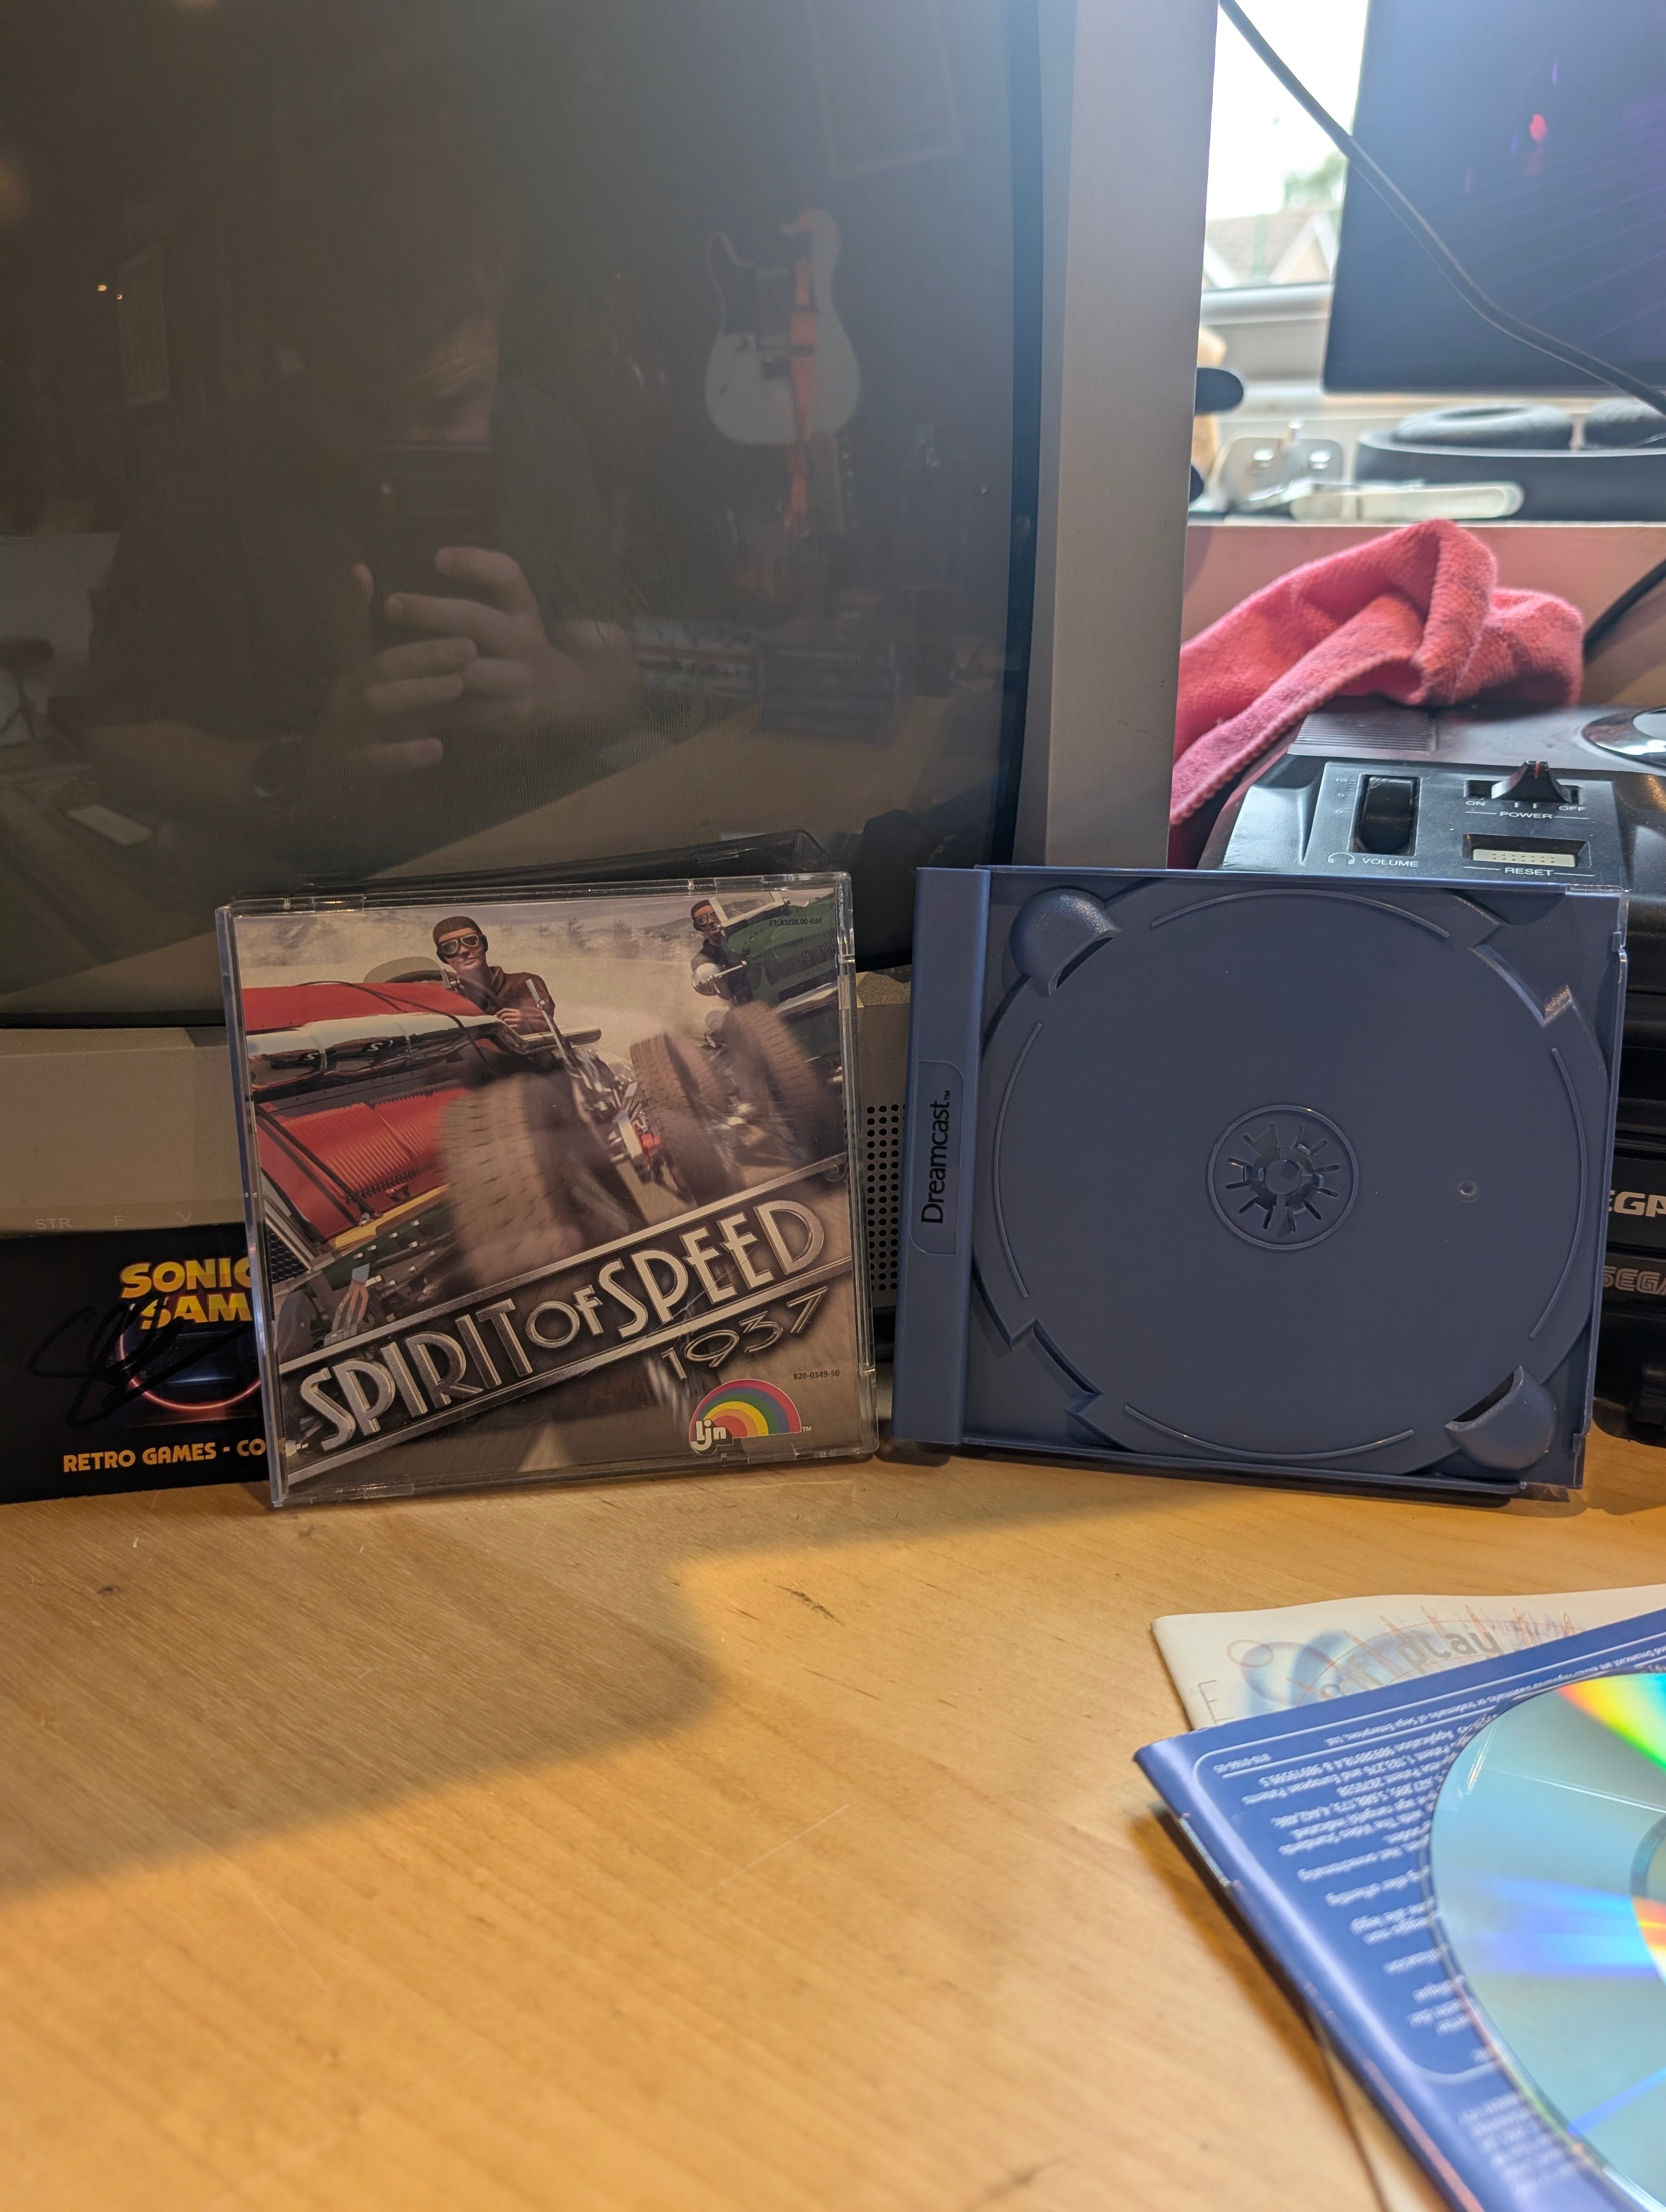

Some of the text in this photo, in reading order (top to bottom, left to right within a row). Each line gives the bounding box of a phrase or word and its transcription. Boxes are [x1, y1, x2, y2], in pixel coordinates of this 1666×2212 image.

[1362, 858, 1419, 867] VOLUME
[1504, 867, 1554, 876] RESET
[921, 1100, 950, 1224] Dreamcast
[35, 1217, 72, 1230] STR
[299, 1300, 536, 1451] SPIRIT
[593, 1200, 826, 1339] SPEED
[659, 1286, 829, 1380] 1937
[793, 1369, 841, 1380] 820-0349-50
[63, 1450, 136, 1473] RETRO
[143, 1442, 217, 1465] GAMES
